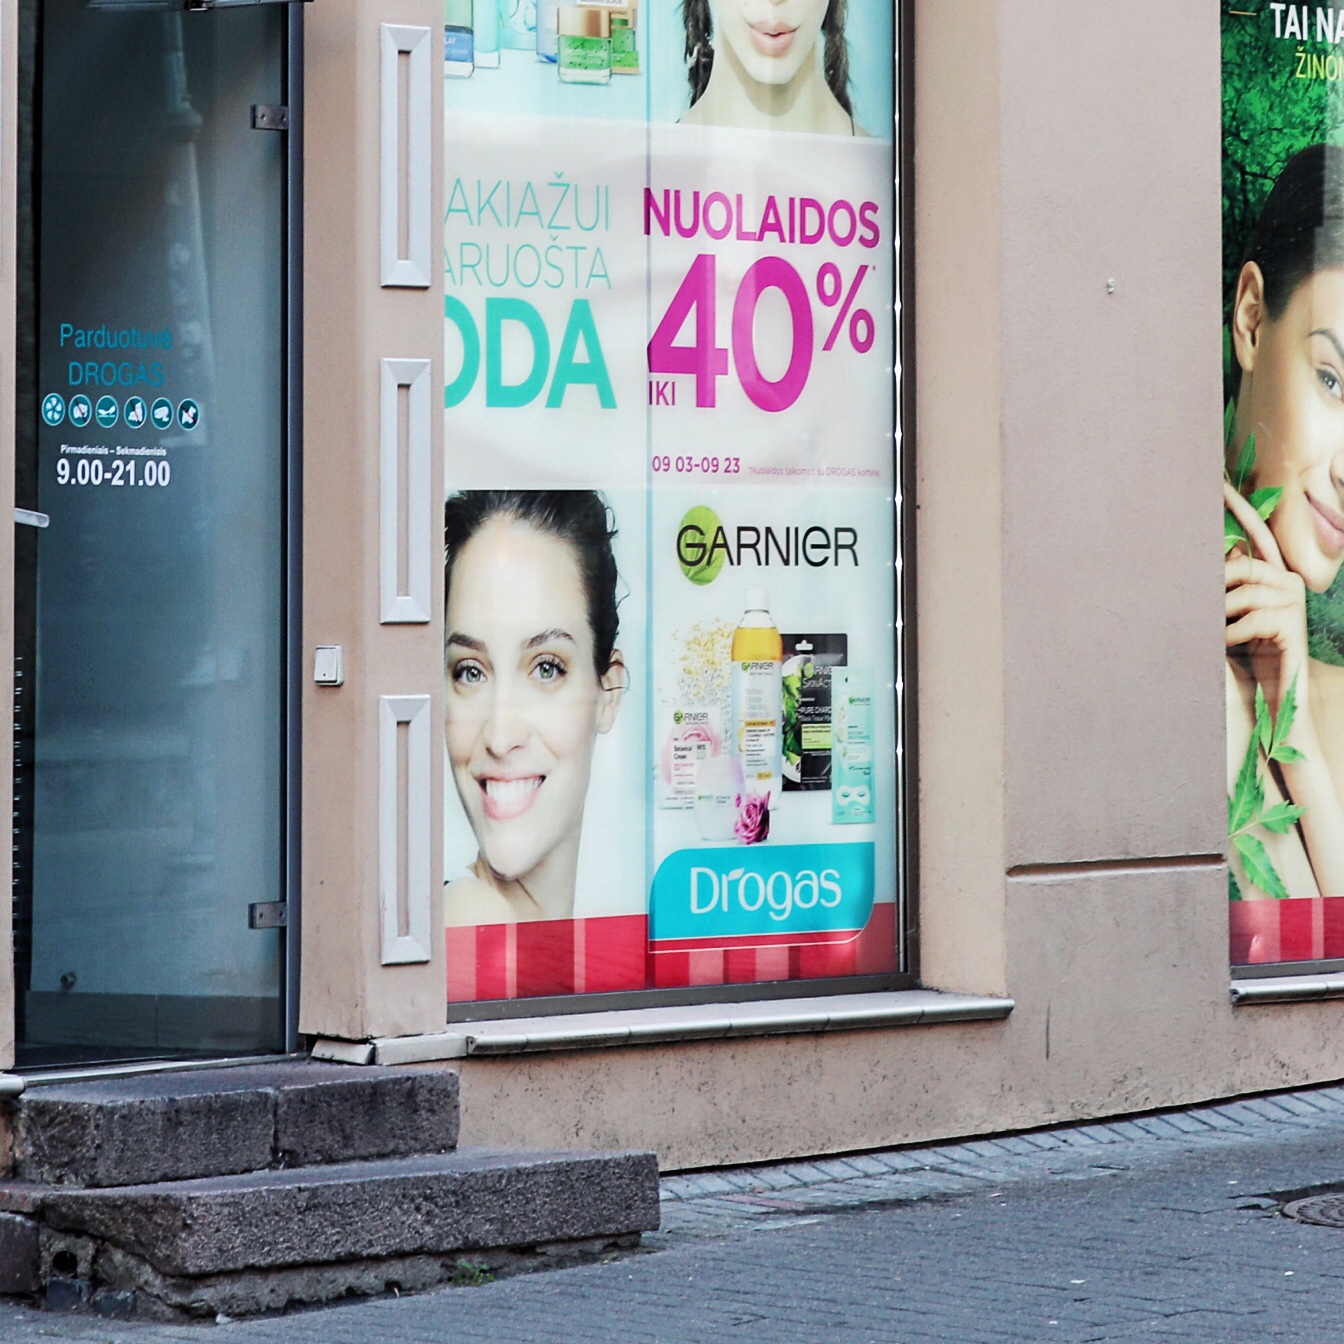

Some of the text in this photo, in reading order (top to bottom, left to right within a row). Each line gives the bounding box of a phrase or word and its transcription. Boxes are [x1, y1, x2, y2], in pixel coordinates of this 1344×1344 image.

[1269, 1, 1308, 42] TAI
[643, 186, 881, 249] NUOLAIDOS
[59, 323, 174, 349] Parduotuvė
[68, 361, 165, 387] DROGAS
[648, 381, 676, 407] IKI
[56, 458, 171, 487] 9.00-21.00
[652, 455, 671, 473] 09
[723, 457, 741, 474] 23
[689, 866, 842, 921] Drogas
